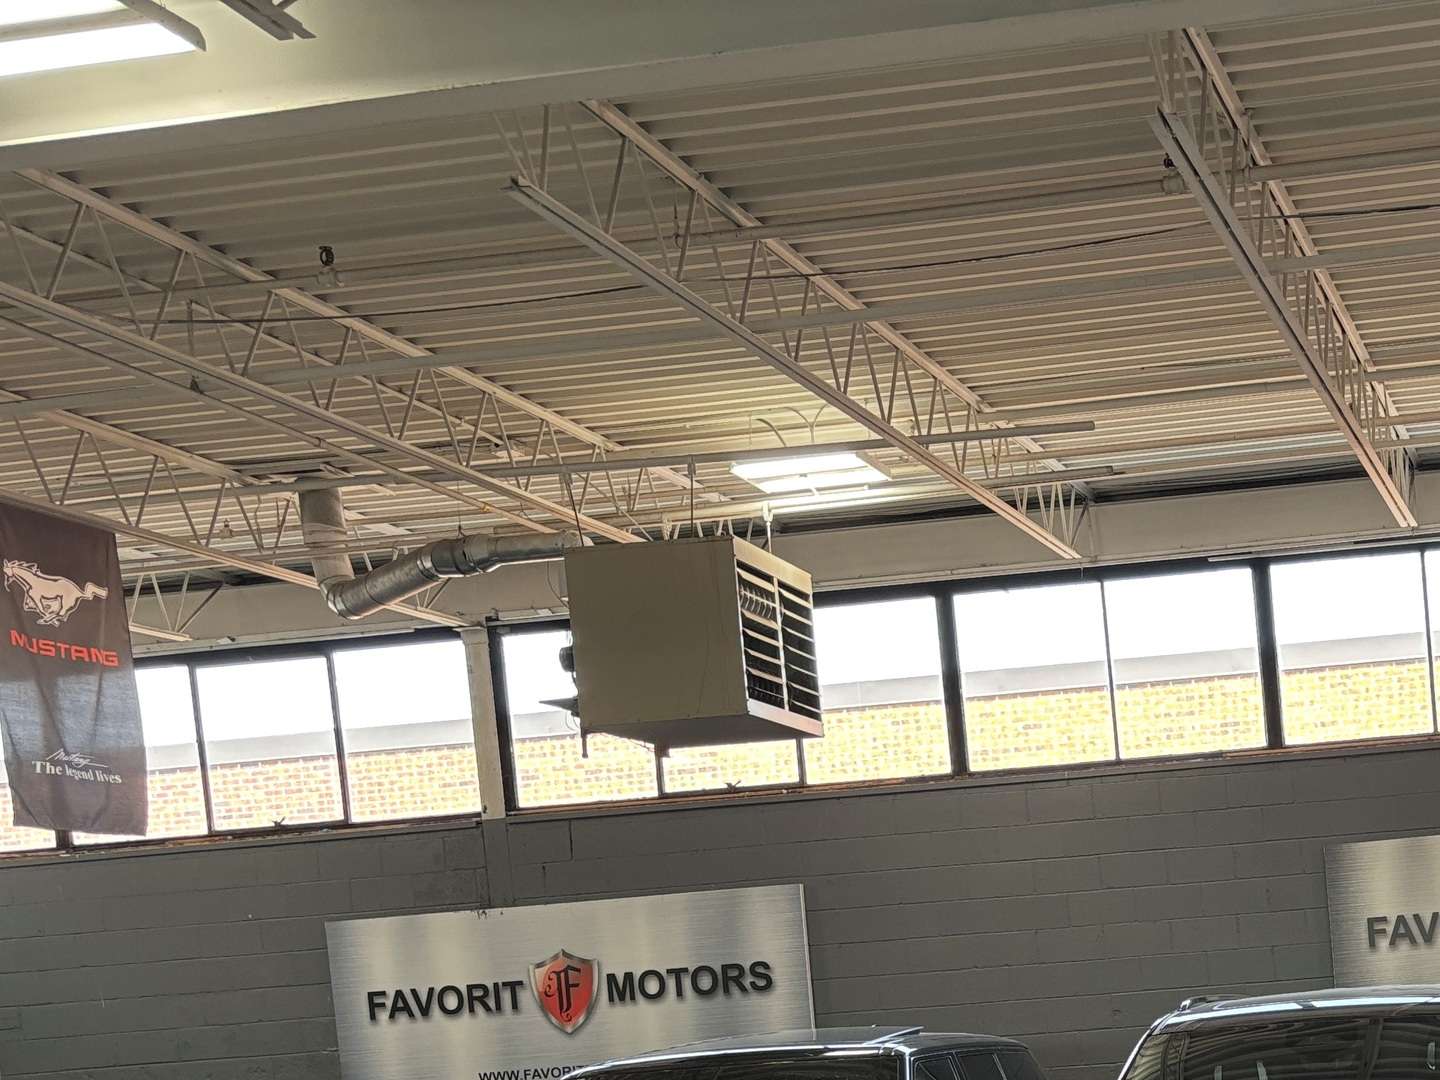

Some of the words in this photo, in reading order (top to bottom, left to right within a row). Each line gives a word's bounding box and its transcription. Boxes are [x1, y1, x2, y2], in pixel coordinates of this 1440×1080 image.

[32, 760, 62, 775] The
[64, 764, 94, 781] legend
[95, 769, 122, 784] lives
[367, 980, 525, 1021] FAVORIT
[606, 960, 773, 1004] MOTORS
